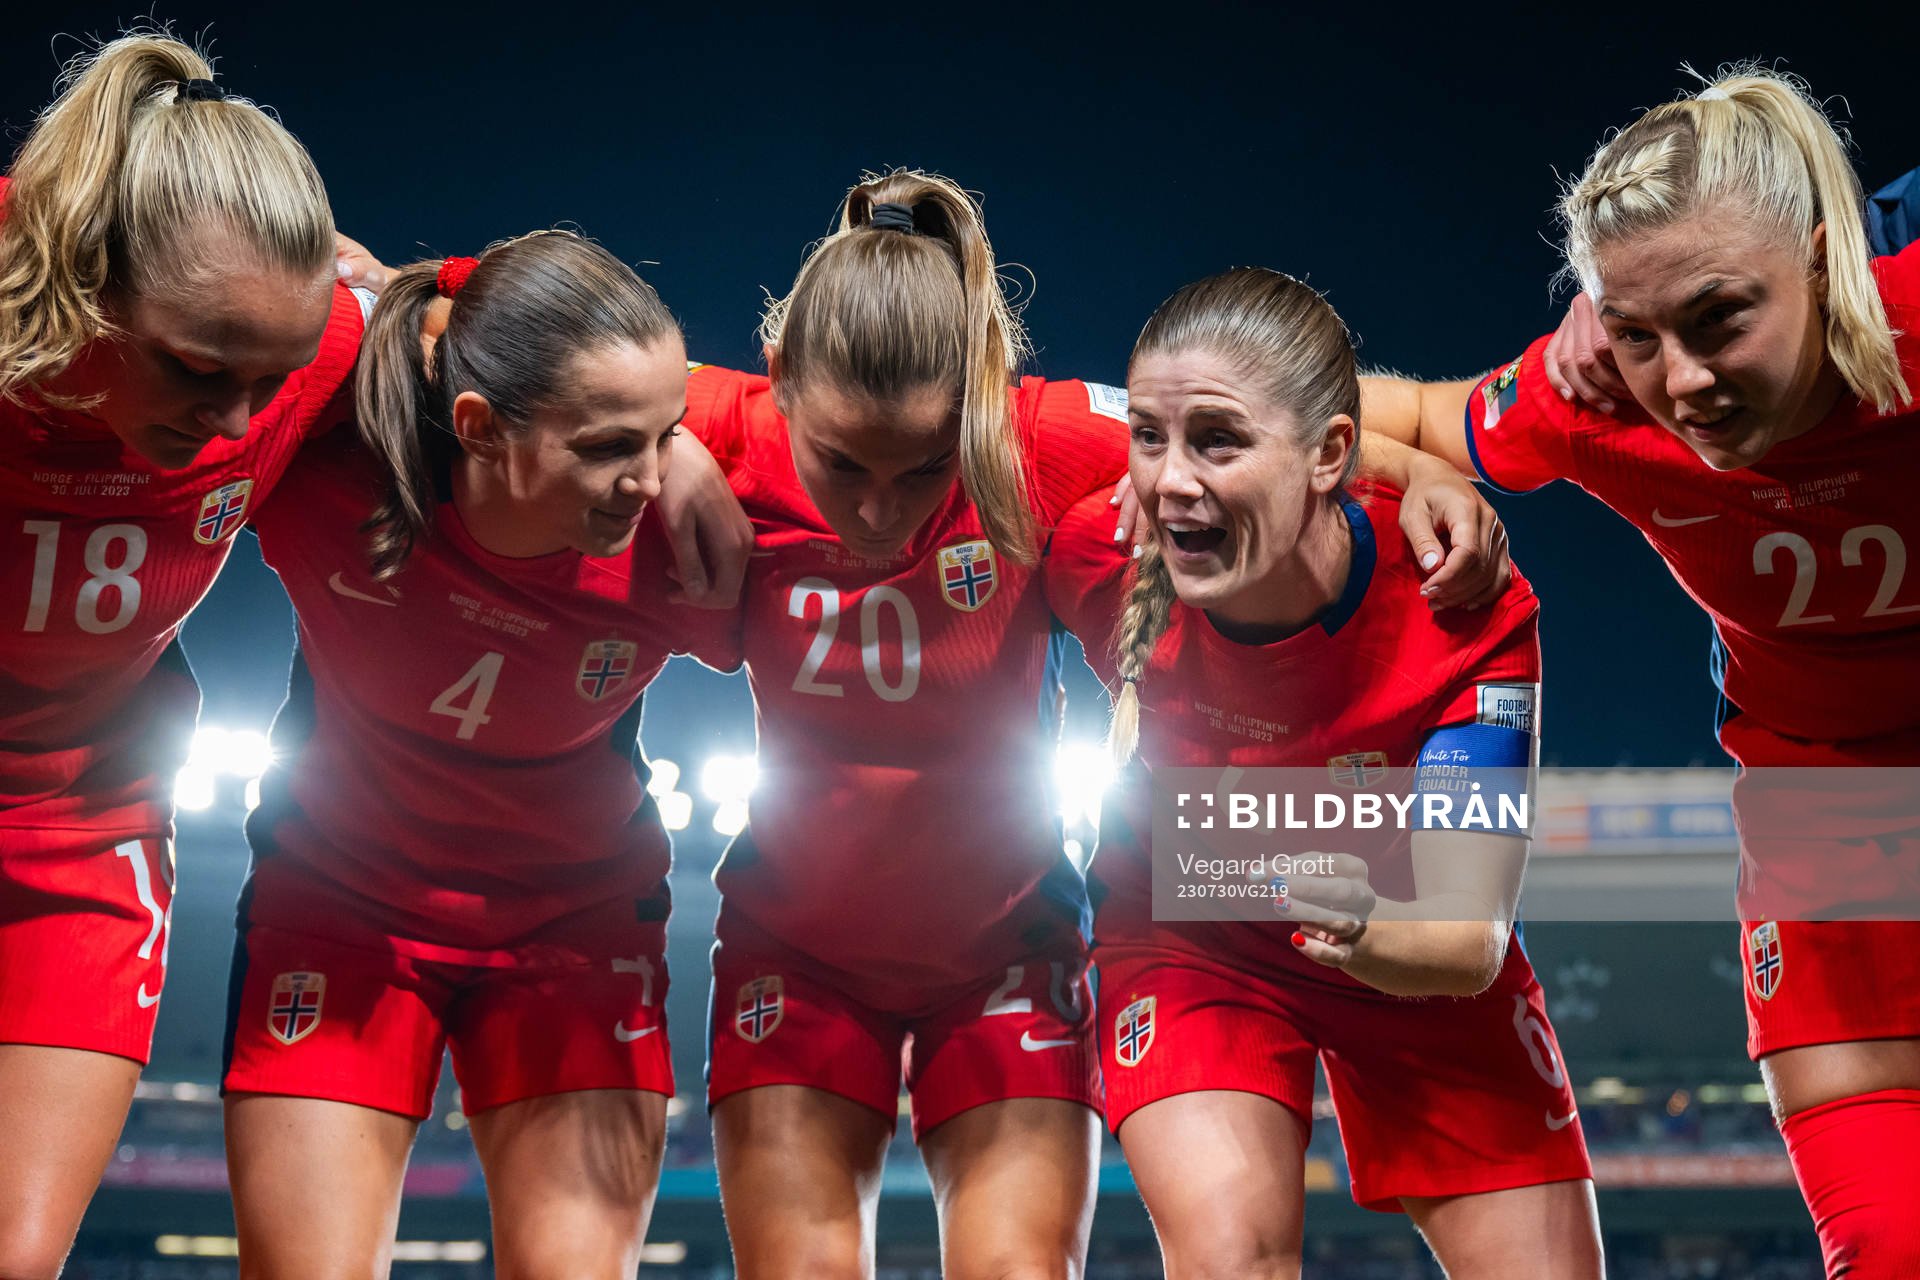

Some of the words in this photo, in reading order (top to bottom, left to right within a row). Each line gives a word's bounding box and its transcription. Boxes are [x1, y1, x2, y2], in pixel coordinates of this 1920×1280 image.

[33, 471, 73, 484] NORGE
[73, 485, 97, 496] JULI
[100, 485, 130, 497] 2023
[1774, 498, 1793, 510] 30.
[1794, 495, 1816, 508] JULI
[1818, 487, 1846, 503] 2023
[23, 520, 148, 635] 18
[1753, 524, 1920, 628] 22
[788, 576, 921, 702] 20
[429, 651, 504, 740] 4
[1497, 698, 1533, 713] FOOTBALL
[1194, 701, 1224, 720] NORGE
[1233, 714, 1289, 735] FILIPPINENE
[1227, 722, 1246, 736] JULI
[1248, 728, 1274, 742] 2023
[1422, 749, 1450, 763] Unite
[1450, 749, 1471, 762] For
[1420, 764, 1469, 778] GENDER
[1418, 778, 1478, 793] EQUALITY
[1513, 993, 1565, 1088] 6
